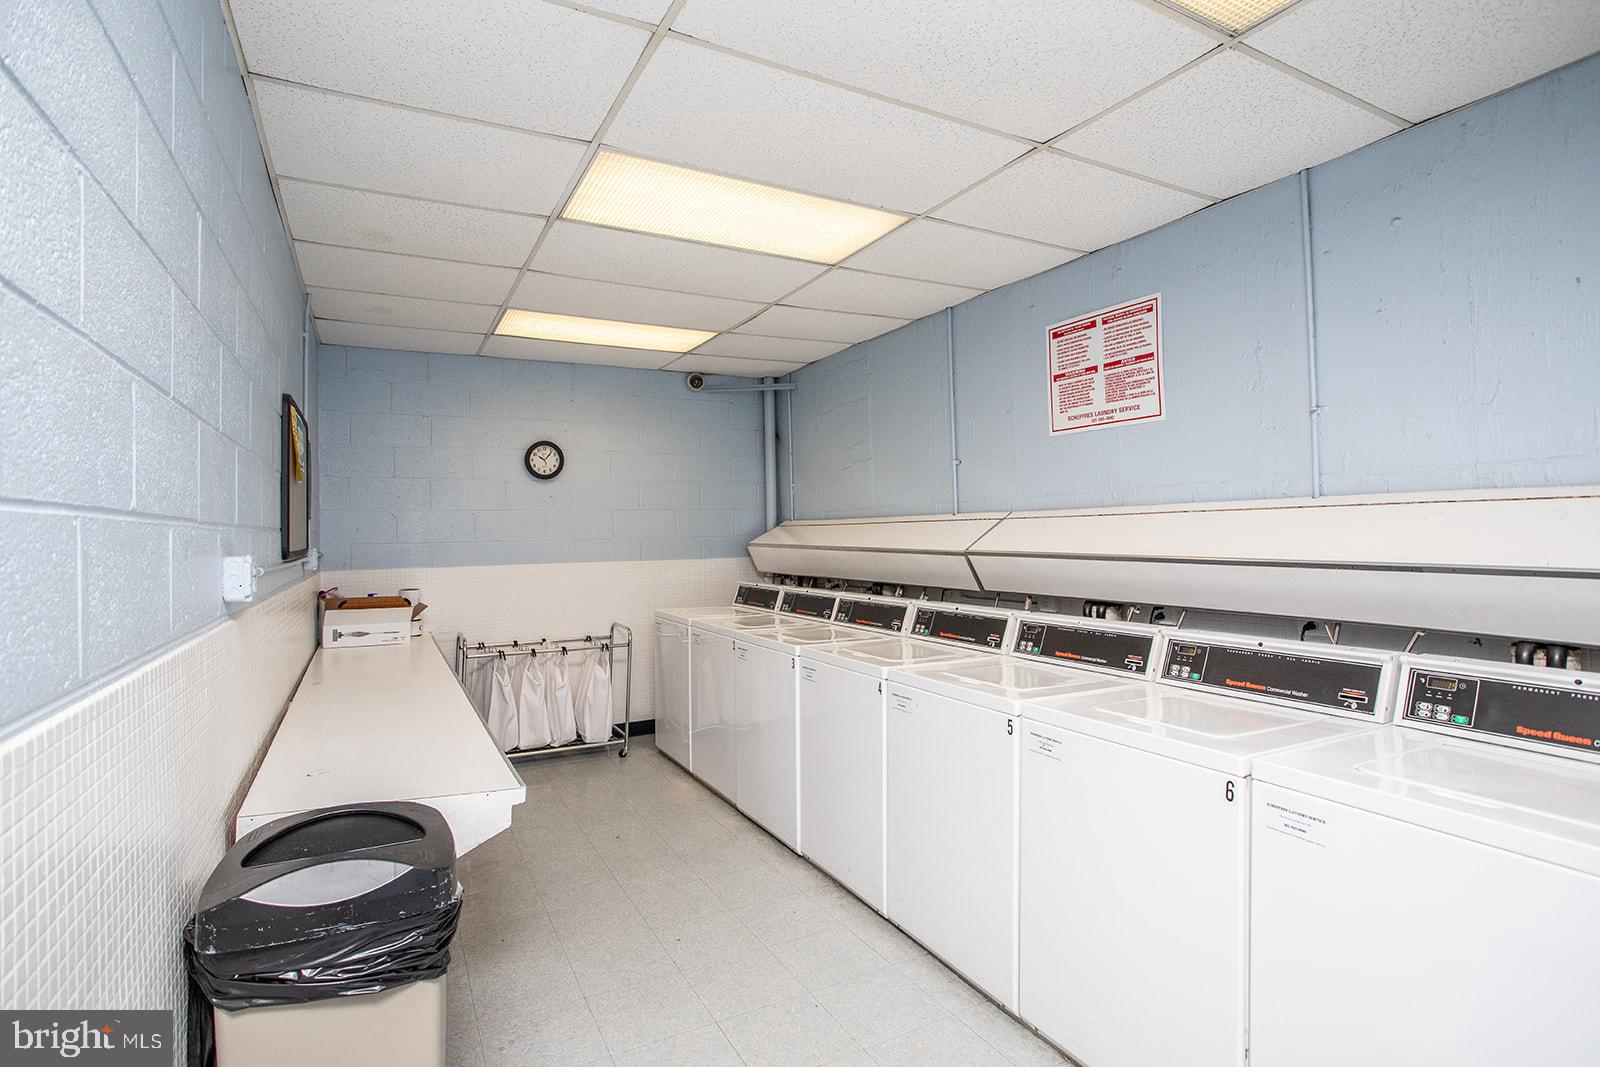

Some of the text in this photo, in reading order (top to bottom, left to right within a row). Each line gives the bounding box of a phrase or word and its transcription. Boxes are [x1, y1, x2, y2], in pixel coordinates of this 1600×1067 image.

[1118, 403, 1140, 413] SERVICE
[1266, 686, 1291, 695] Commercial
[1292, 690, 1309, 698] Washer
[1512, 685, 1560, 696] PERMANENT
[1007, 719, 1013, 736] 5
[1515, 725, 1552, 739] Speed
[1552, 731, 1592, 746] Queen
[1225, 780, 1235, 802] 6
